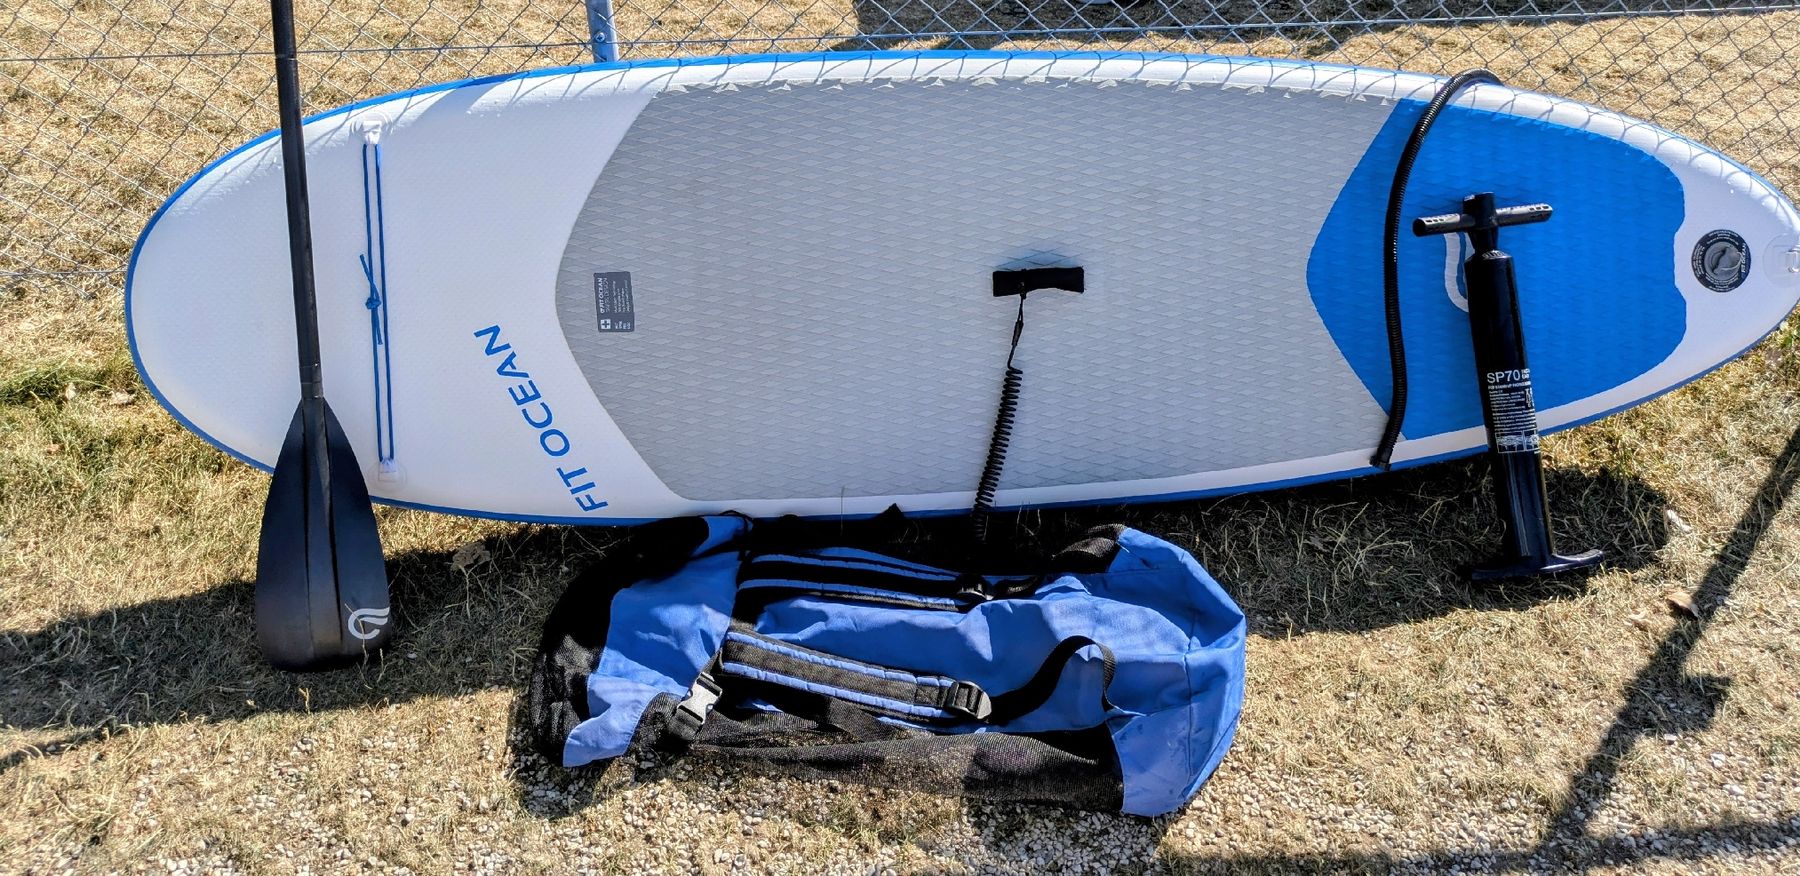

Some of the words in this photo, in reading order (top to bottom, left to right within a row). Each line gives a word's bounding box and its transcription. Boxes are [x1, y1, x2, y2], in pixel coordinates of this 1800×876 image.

[473, 324, 571, 457] OCEAN
[1486, 369, 1521, 384] SP70
[556, 467, 609, 512] FIT
